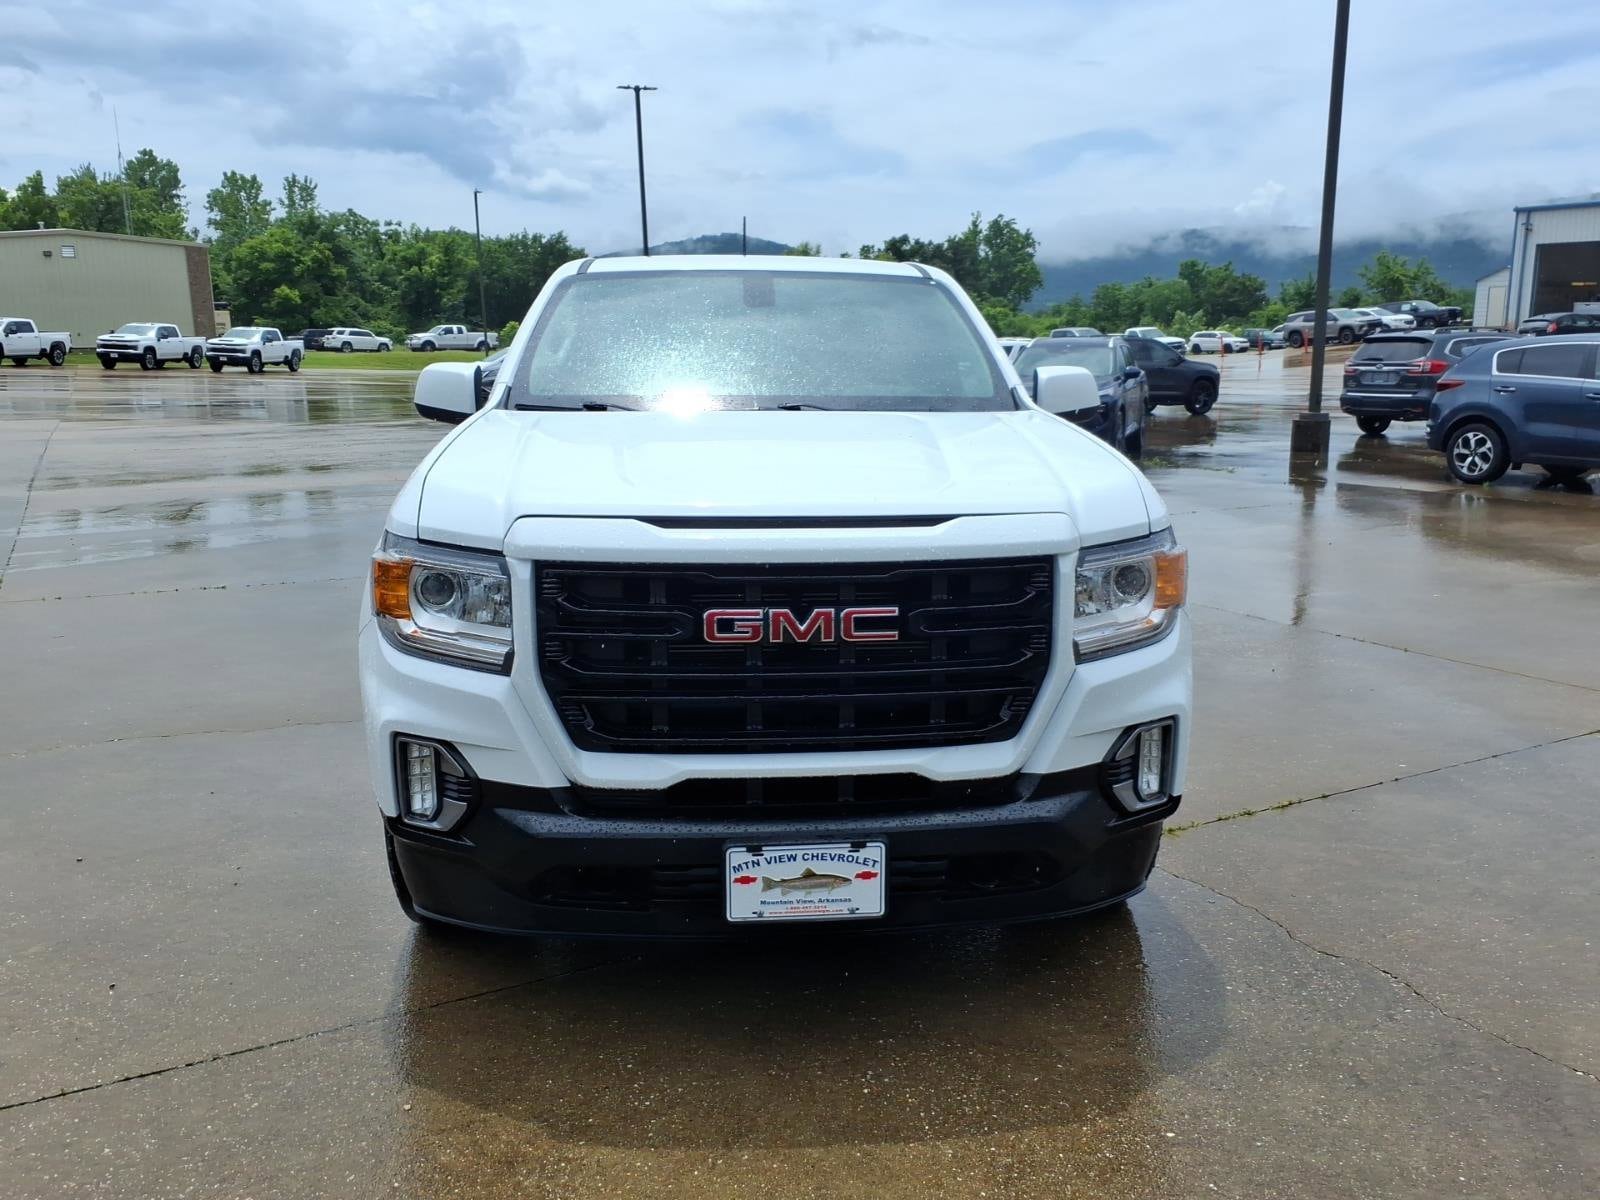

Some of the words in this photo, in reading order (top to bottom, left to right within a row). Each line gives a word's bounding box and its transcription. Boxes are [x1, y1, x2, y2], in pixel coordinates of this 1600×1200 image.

[703, 607, 899, 643] GMC
[732, 859, 761, 874] MTN
[764, 853, 798, 865] VIEW
[801, 852, 880, 868] CHEVROLET
